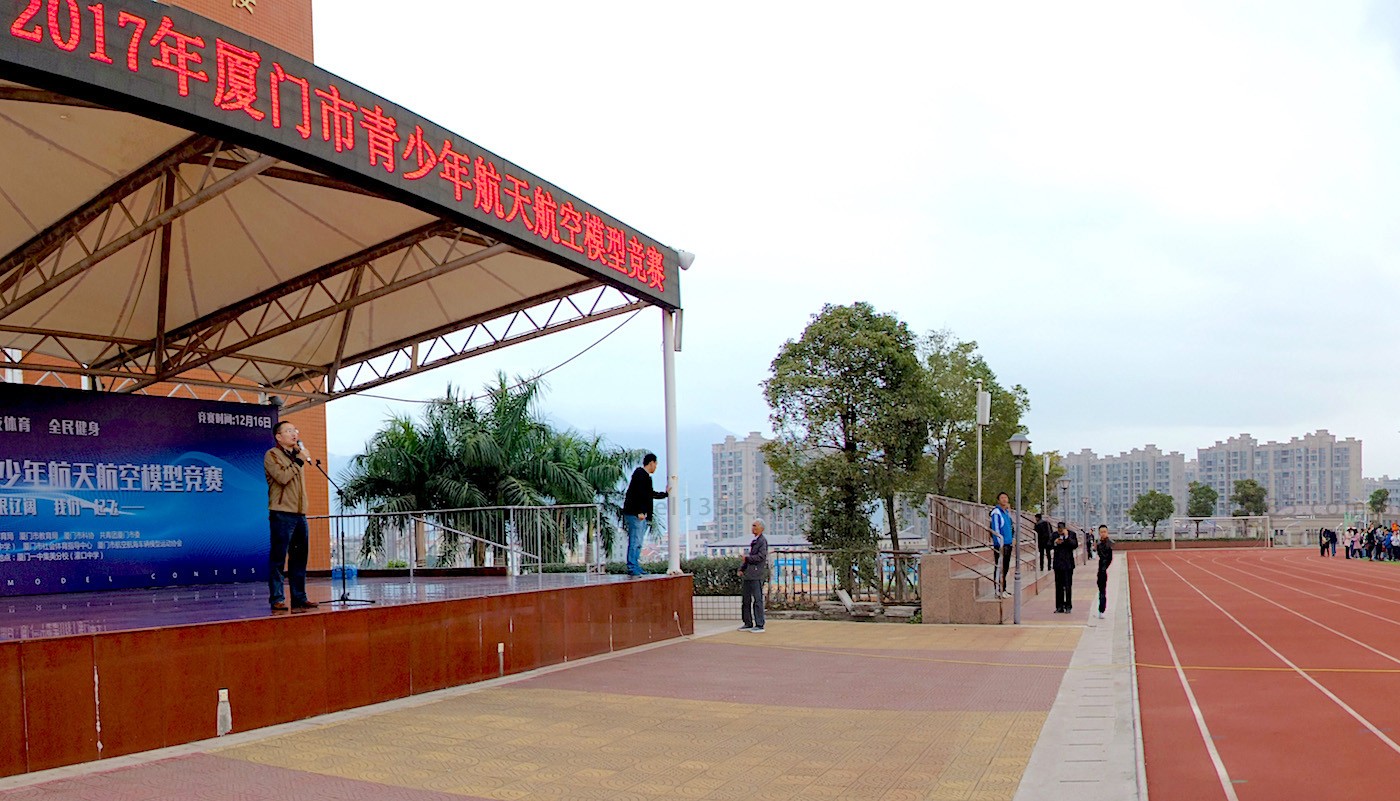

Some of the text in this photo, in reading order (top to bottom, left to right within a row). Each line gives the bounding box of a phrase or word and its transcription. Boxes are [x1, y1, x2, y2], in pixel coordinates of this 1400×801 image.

[10, 0, 666, 292] 2017年厦门市青少年航天航空模型竞赛
[48, 418, 100, 437] 全民健身
[0, 458, 224, 493] 少年航天航空模型竞赛
